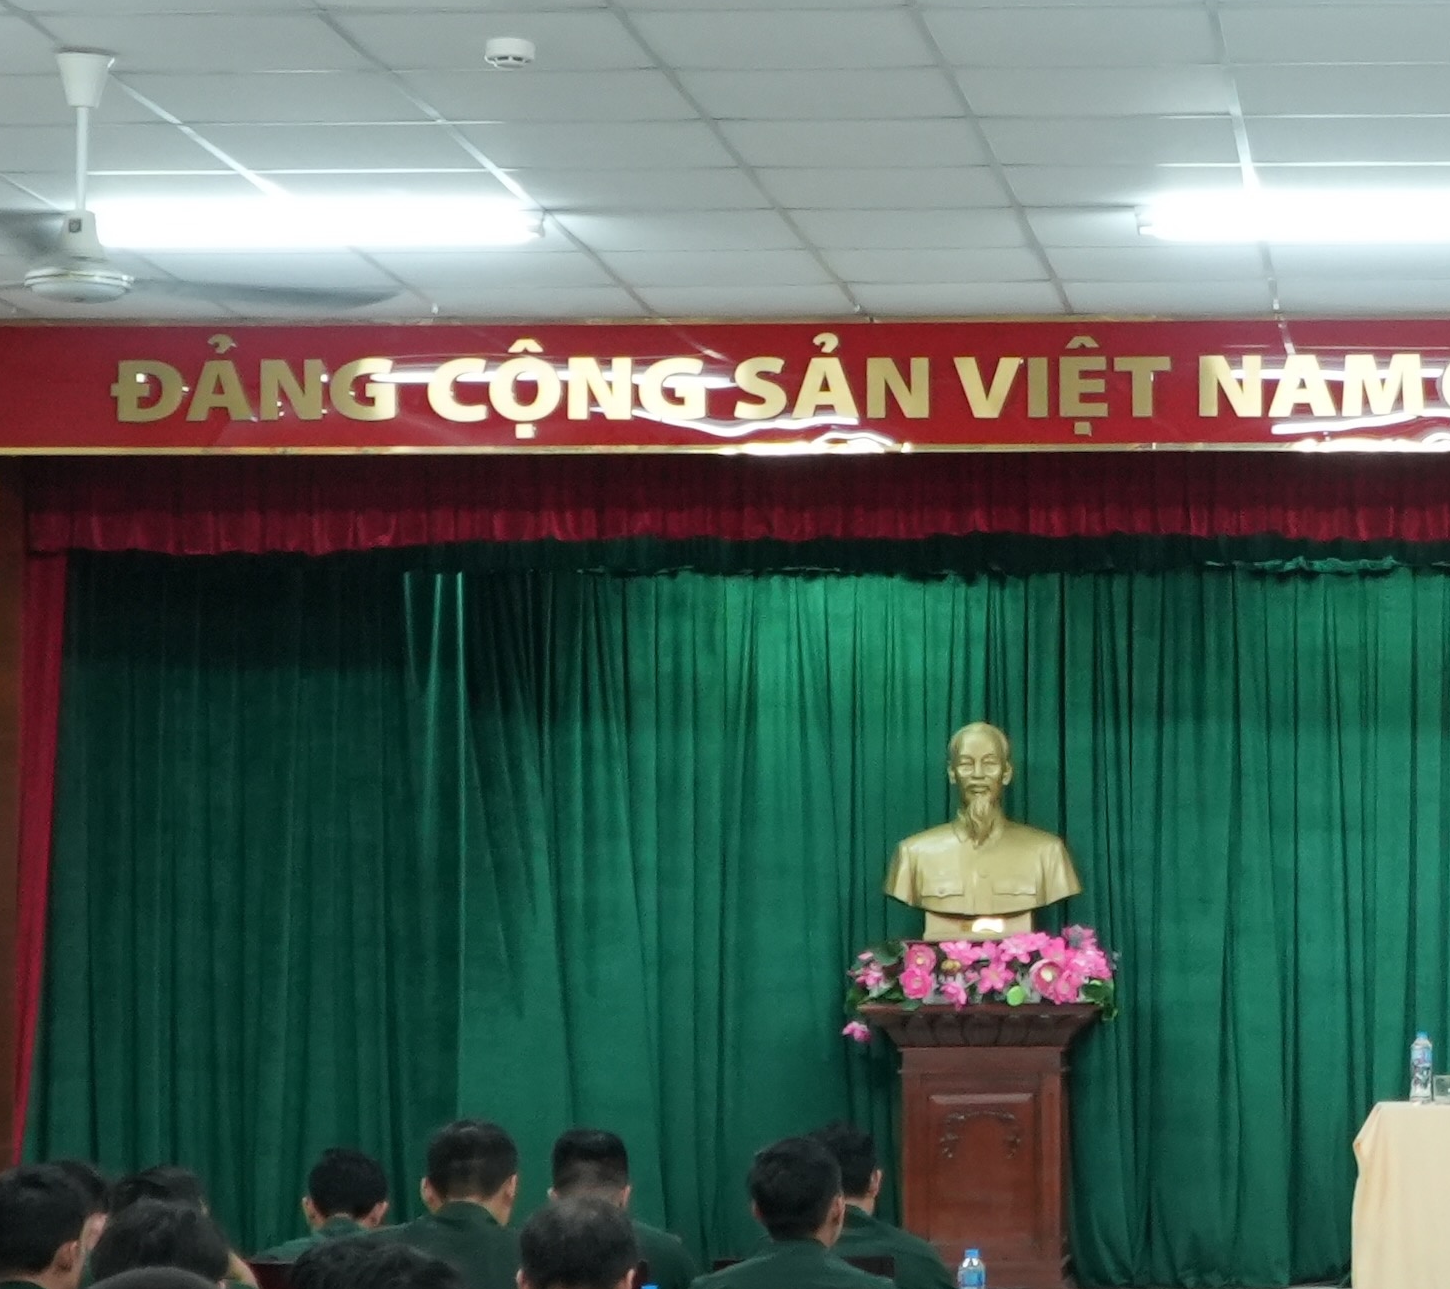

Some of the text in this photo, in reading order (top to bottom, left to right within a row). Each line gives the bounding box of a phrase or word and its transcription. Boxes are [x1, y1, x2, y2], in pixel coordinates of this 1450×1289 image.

[112, 334, 394, 424] ĐẢNG
[426, 339, 707, 439] CỘNG
[735, 333, 930, 422] SẢN
[954, 336, 1170, 436] VIỆT
[1198, 350, 1421, 419] NAM
